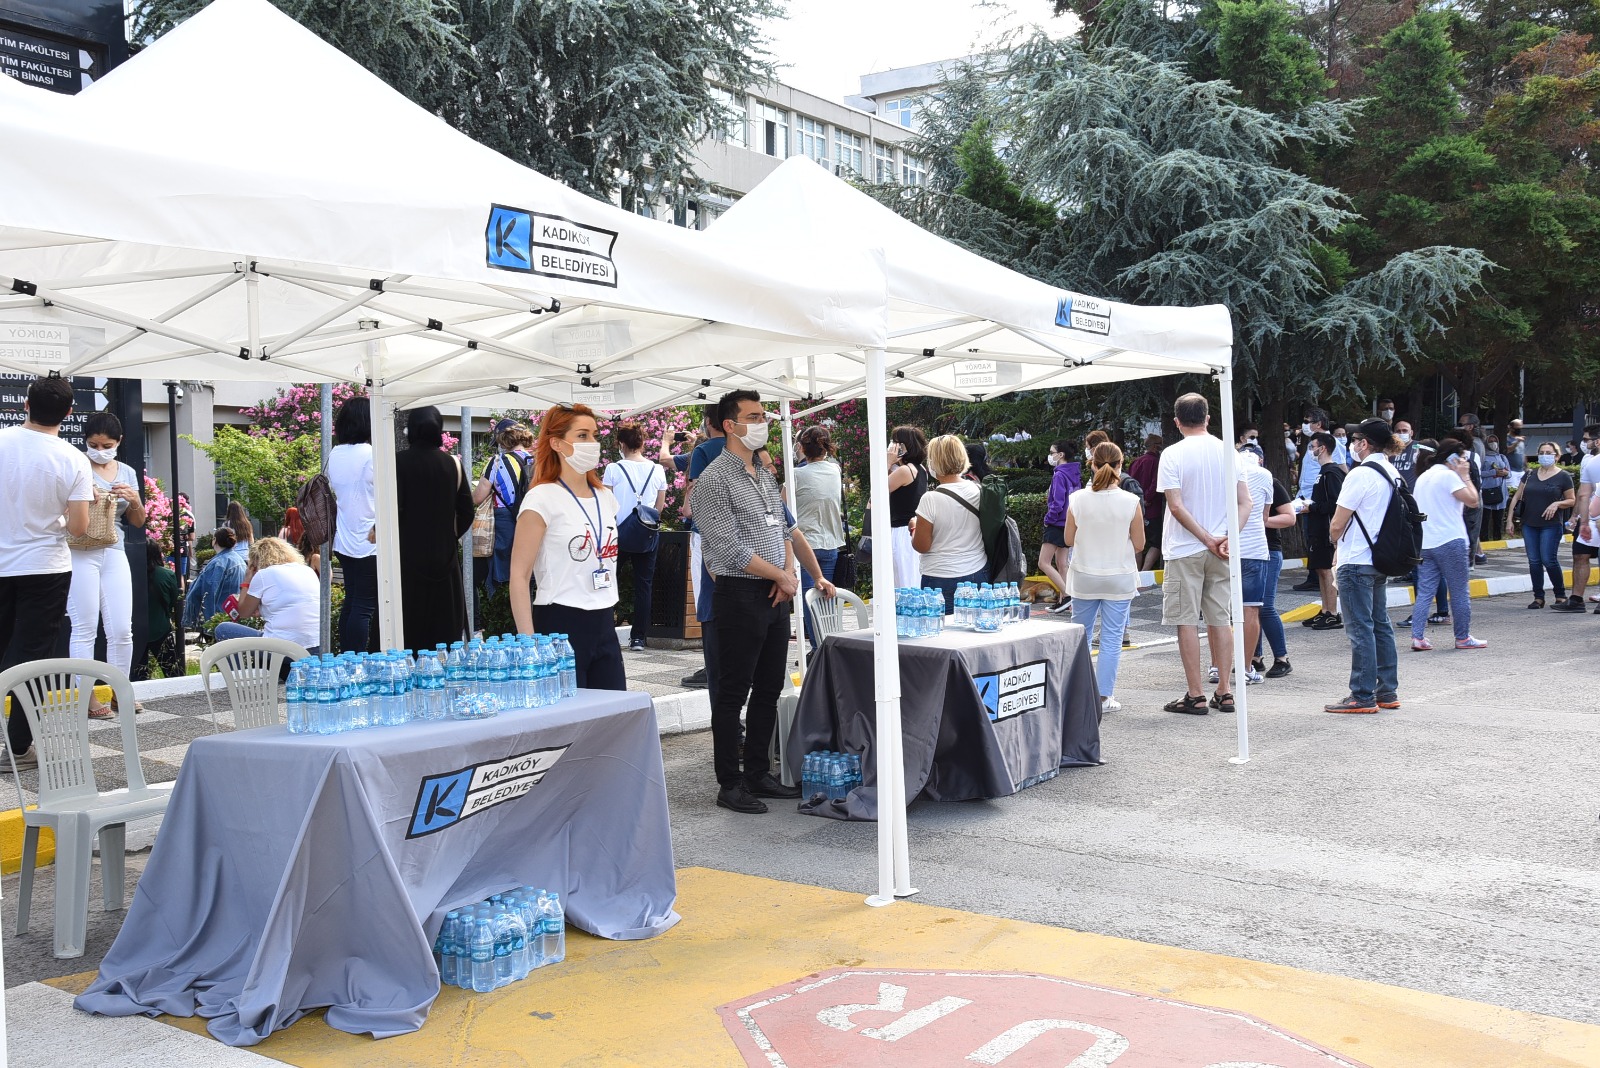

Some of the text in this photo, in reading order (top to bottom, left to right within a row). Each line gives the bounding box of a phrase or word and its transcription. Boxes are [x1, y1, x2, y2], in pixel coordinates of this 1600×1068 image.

[19, 41, 70, 61] FAKÜLTESİ
[21, 60, 72, 78] FAKÜLTESİ
[21, 70, 54, 85] BİNASI
[543, 225, 591, 247] KADIKÖY
[541, 254, 609, 277] BELEDİYESİ
[76, 414, 88, 423] VE
[481, 756, 542, 784] KADIKÖY
